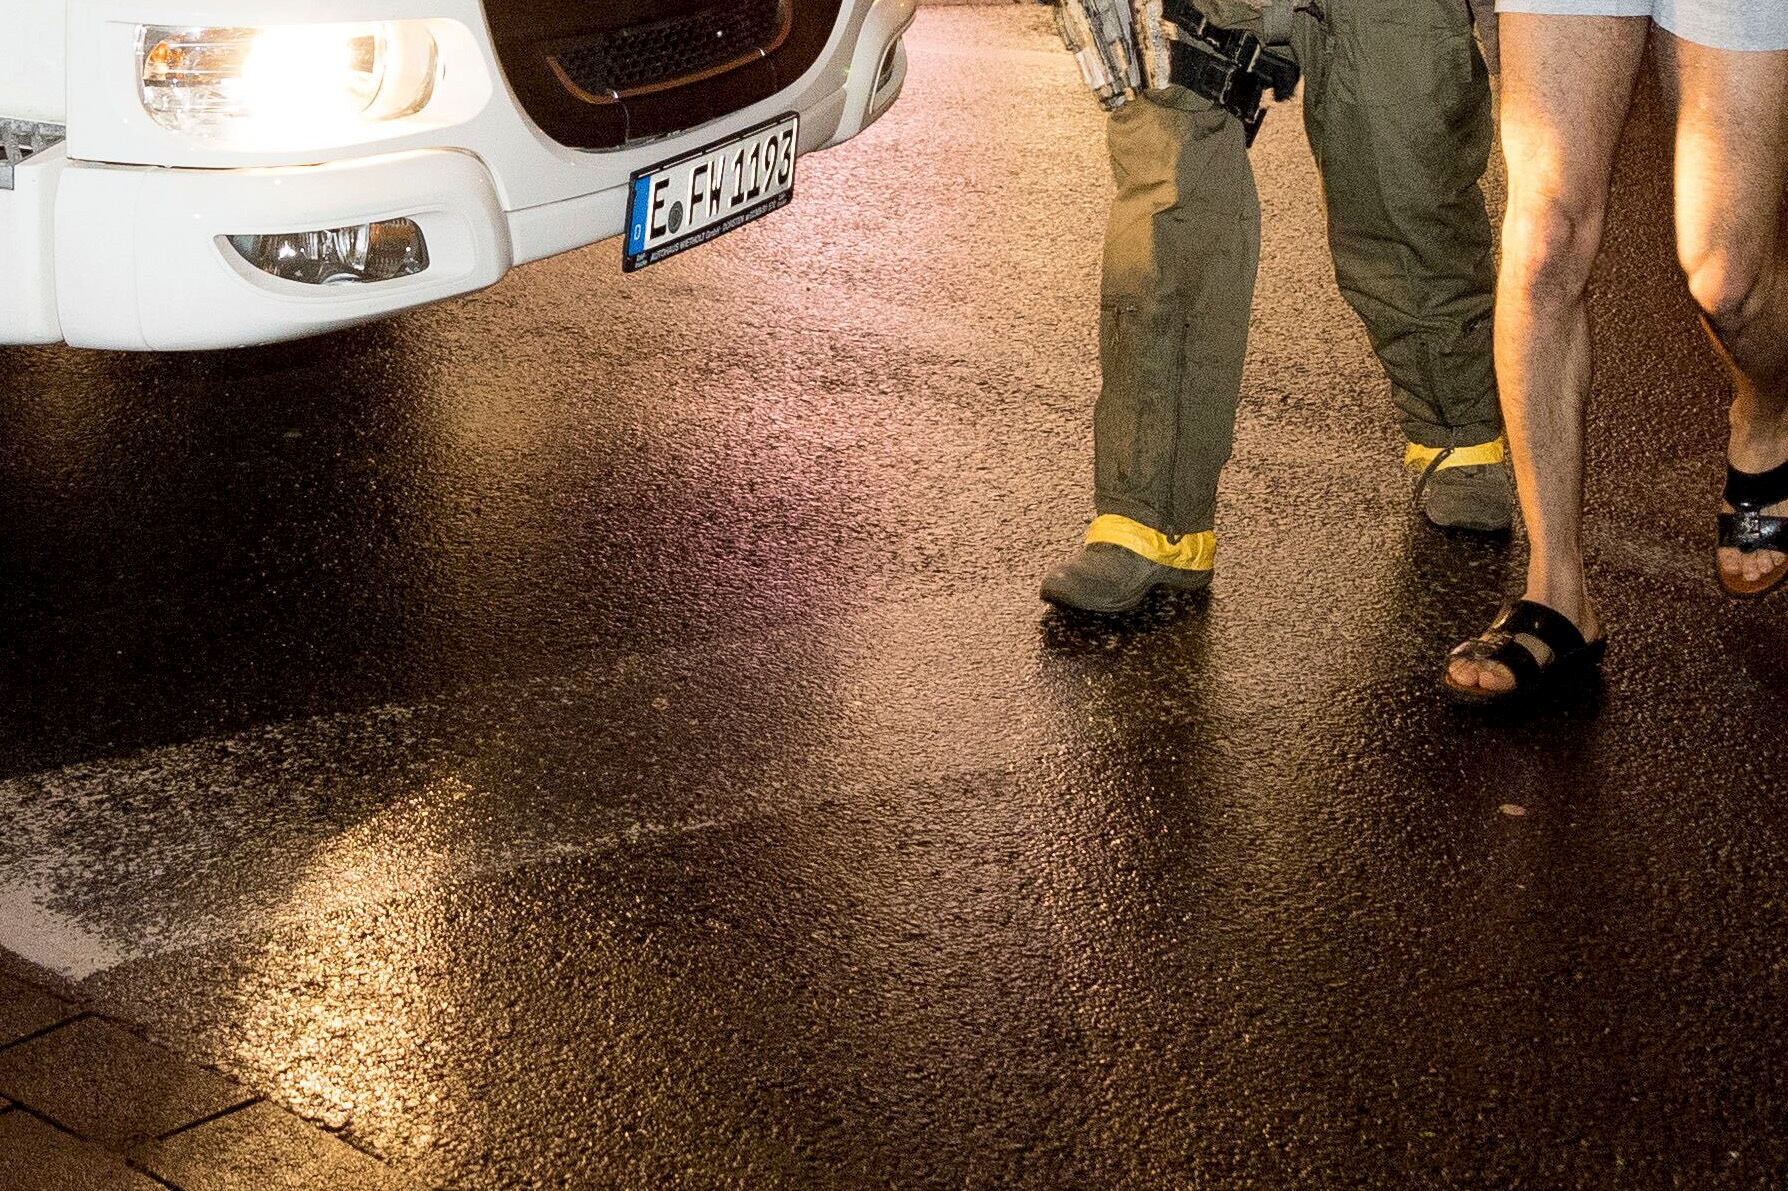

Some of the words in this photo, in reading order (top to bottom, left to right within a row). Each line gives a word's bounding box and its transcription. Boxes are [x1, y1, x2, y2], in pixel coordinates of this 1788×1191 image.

[650, 178, 670, 239] E
[686, 154, 726, 225] FW
[728, 129, 794, 208] 1193
